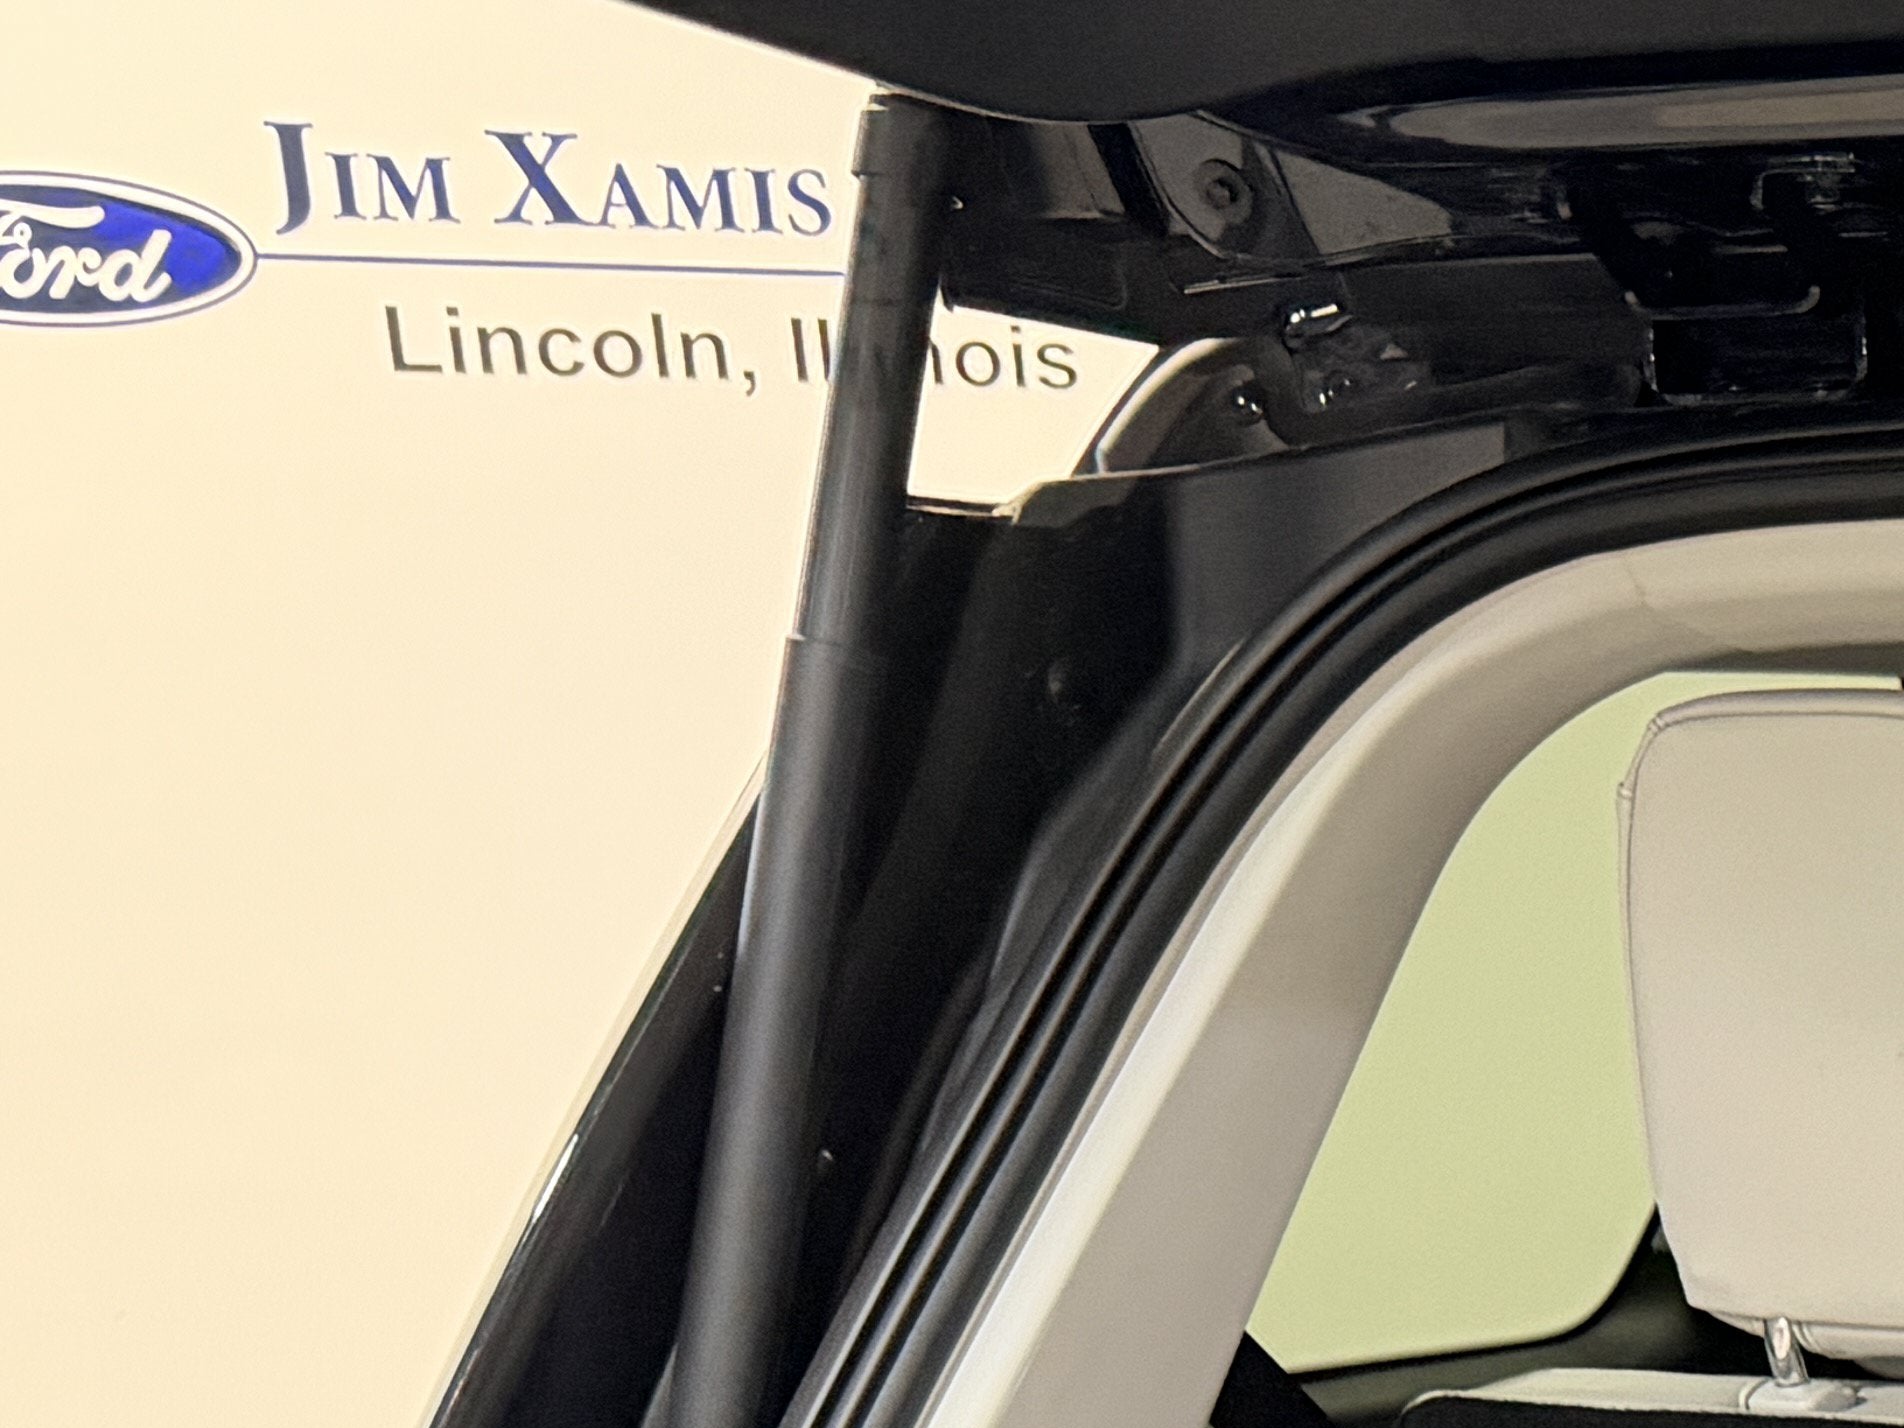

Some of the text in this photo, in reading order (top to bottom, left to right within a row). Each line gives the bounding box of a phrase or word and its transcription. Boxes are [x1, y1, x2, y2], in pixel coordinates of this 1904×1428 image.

[263, 121, 832, 236] JIM XAMIS
[386, 306, 1078, 397] Lincoln, Ilois
